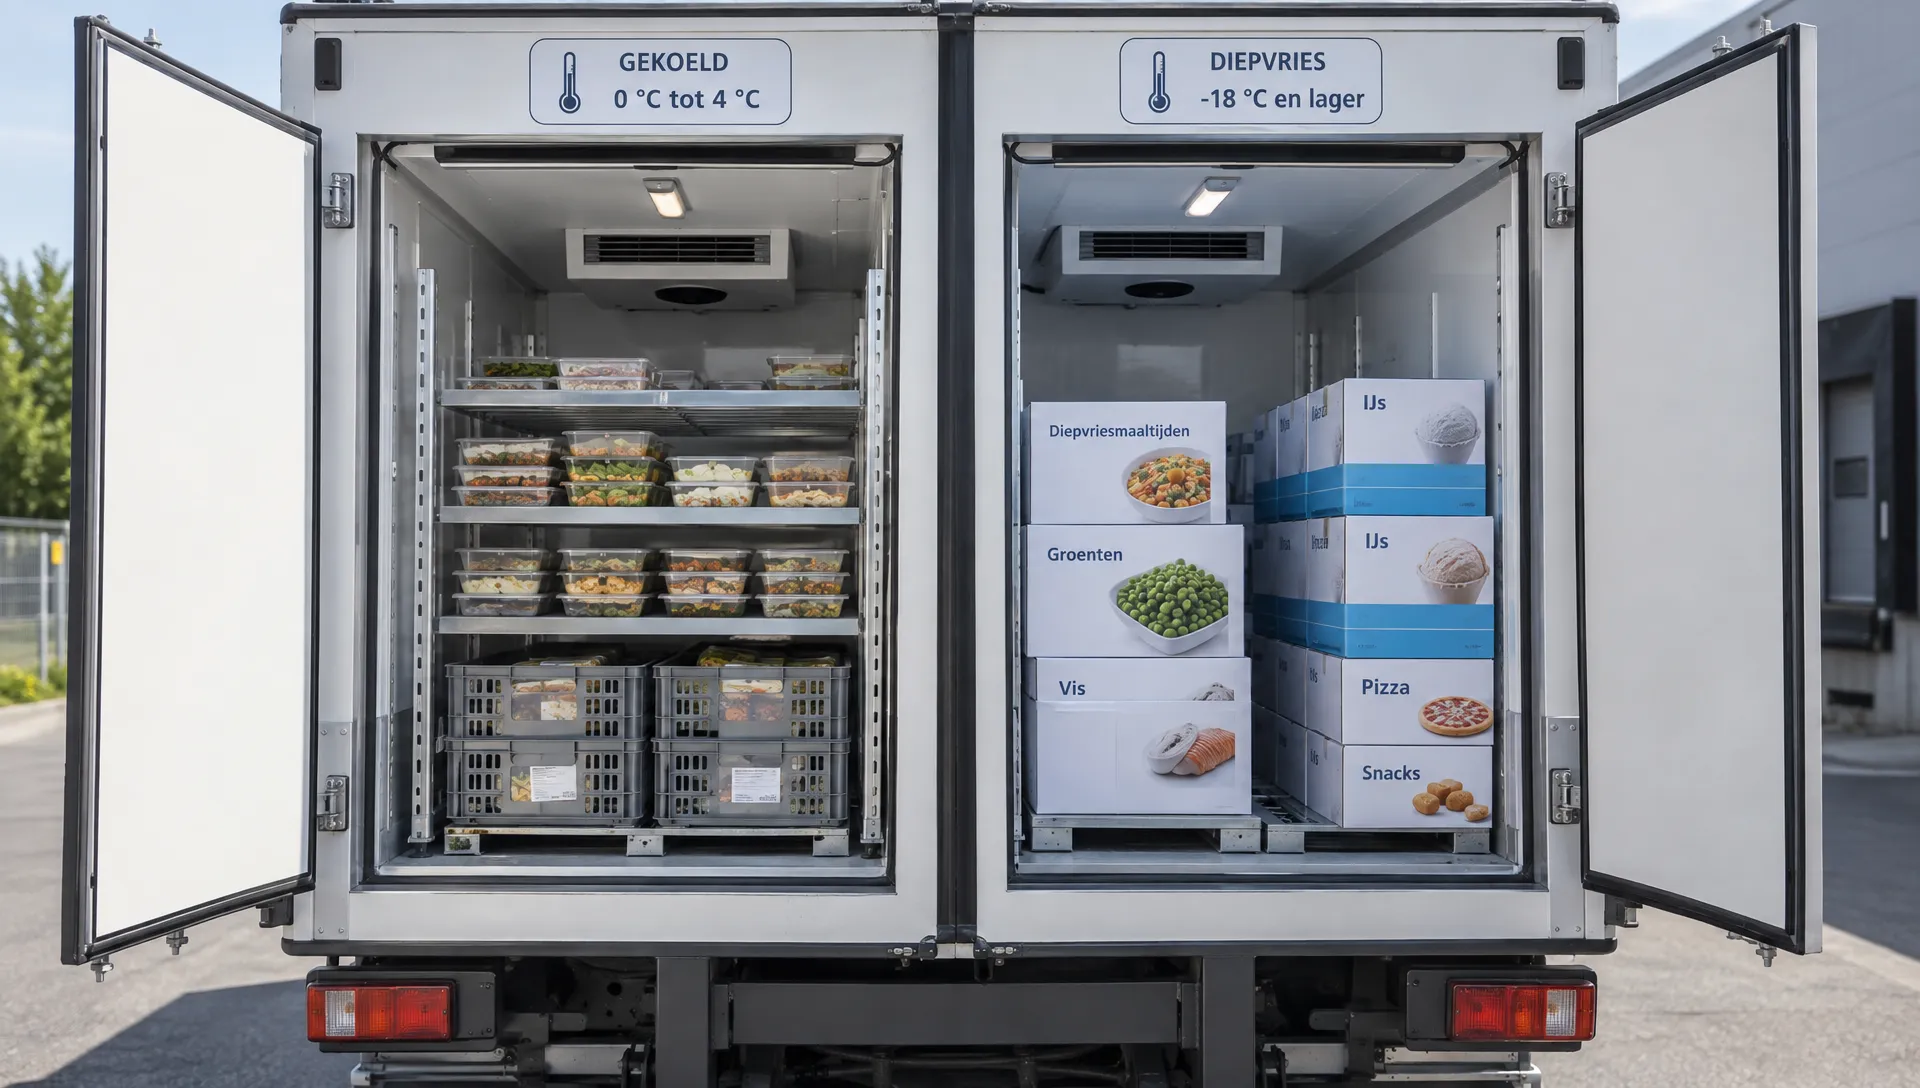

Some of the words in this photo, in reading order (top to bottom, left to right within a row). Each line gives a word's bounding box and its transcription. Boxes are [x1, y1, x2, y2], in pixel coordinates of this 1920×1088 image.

[619, 51, 729, 72] GEKOELD
[1210, 51, 1326, 72] DIEPVRIES
[613, 89, 628, 109] 0
[636, 88, 661, 109] °C
[668, 90, 705, 109] tot
[712, 89, 727, 109] 4
[735, 88, 760, 109] °C
[1200, 88, 1236, 109] -18
[1243, 88, 1268, 109] °C
[1274, 93, 1301, 109] en
[1309, 87, 1366, 114] lager
[1363, 394, 1387, 411] IJs
[1049, 423, 1190, 441] Diepvriesmaaltijden
[1365, 532, 1389, 550] IJs
[1047, 547, 1123, 562] Groenten
[1058, 680, 1086, 696] Vis
[1362, 678, 1410, 696] Pizza
[1362, 764, 1421, 781] Snacks
